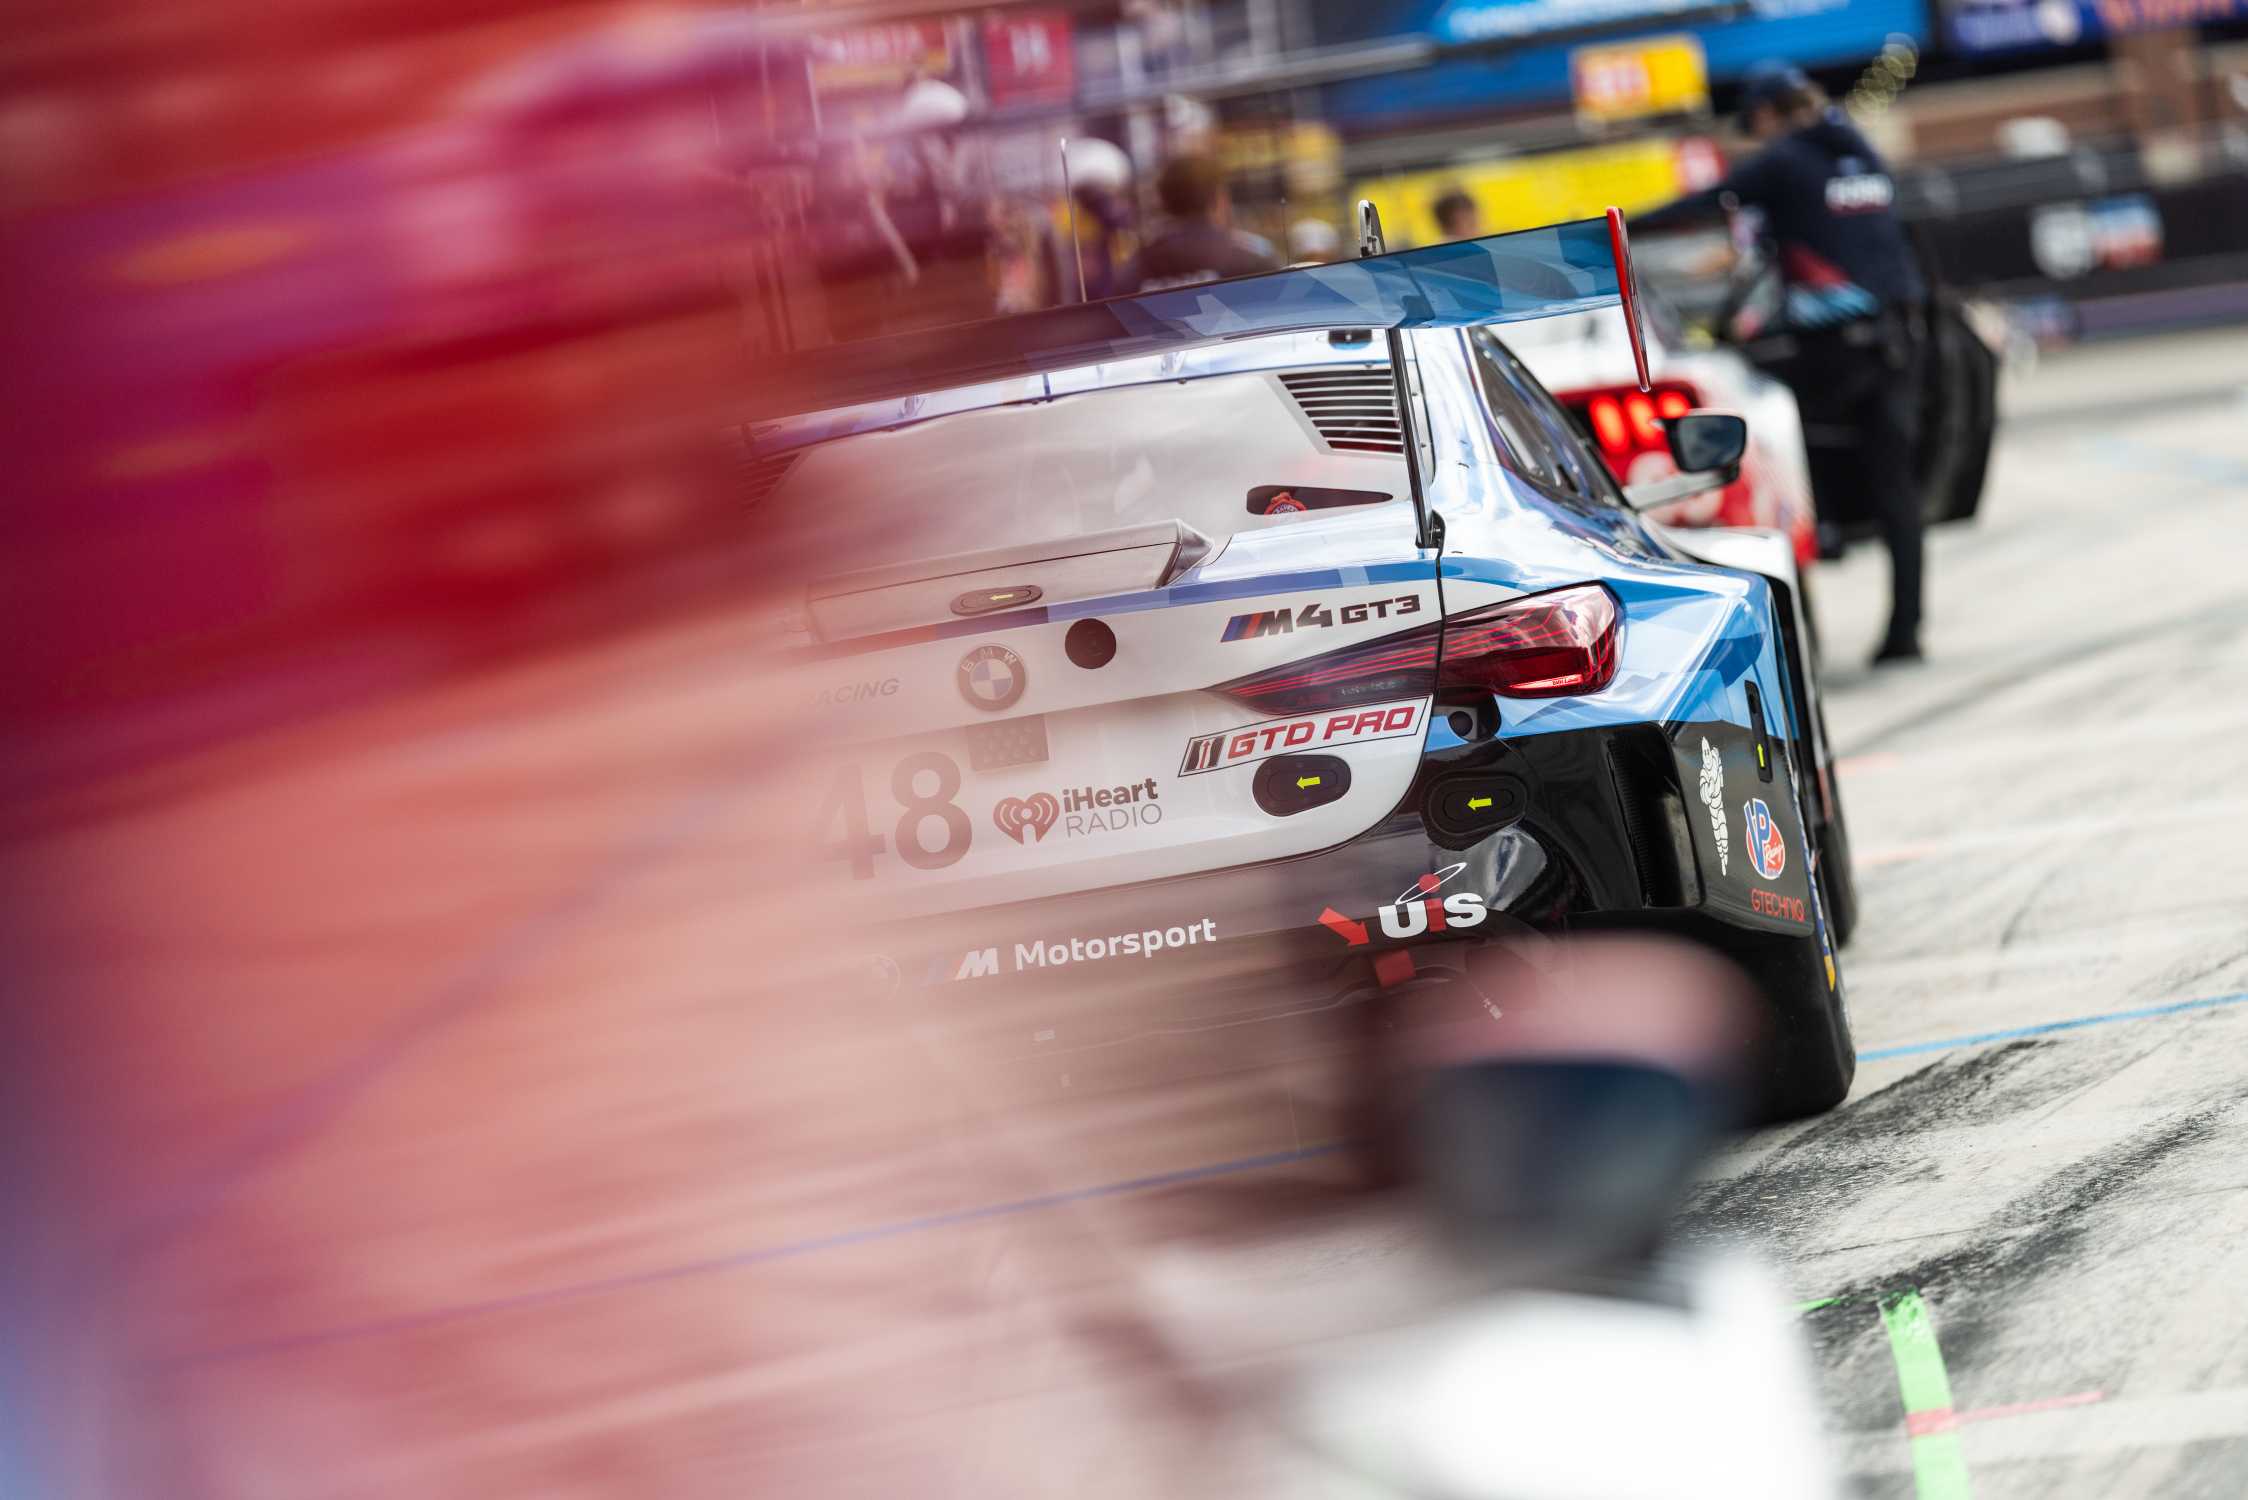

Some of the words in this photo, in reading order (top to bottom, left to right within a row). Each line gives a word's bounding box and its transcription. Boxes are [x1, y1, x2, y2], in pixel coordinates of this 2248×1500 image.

[1257, 604, 1333, 635] M4
[1341, 594, 1420, 624] GT3
[1228, 723, 1315, 759] GTD
[1325, 707, 1416, 739] PRO
[816, 753, 972, 880] 48
[1063, 778, 1158, 816] iHeart
[1065, 803, 1163, 838] RADIO
[1014, 917, 1217, 971] Motorsport
